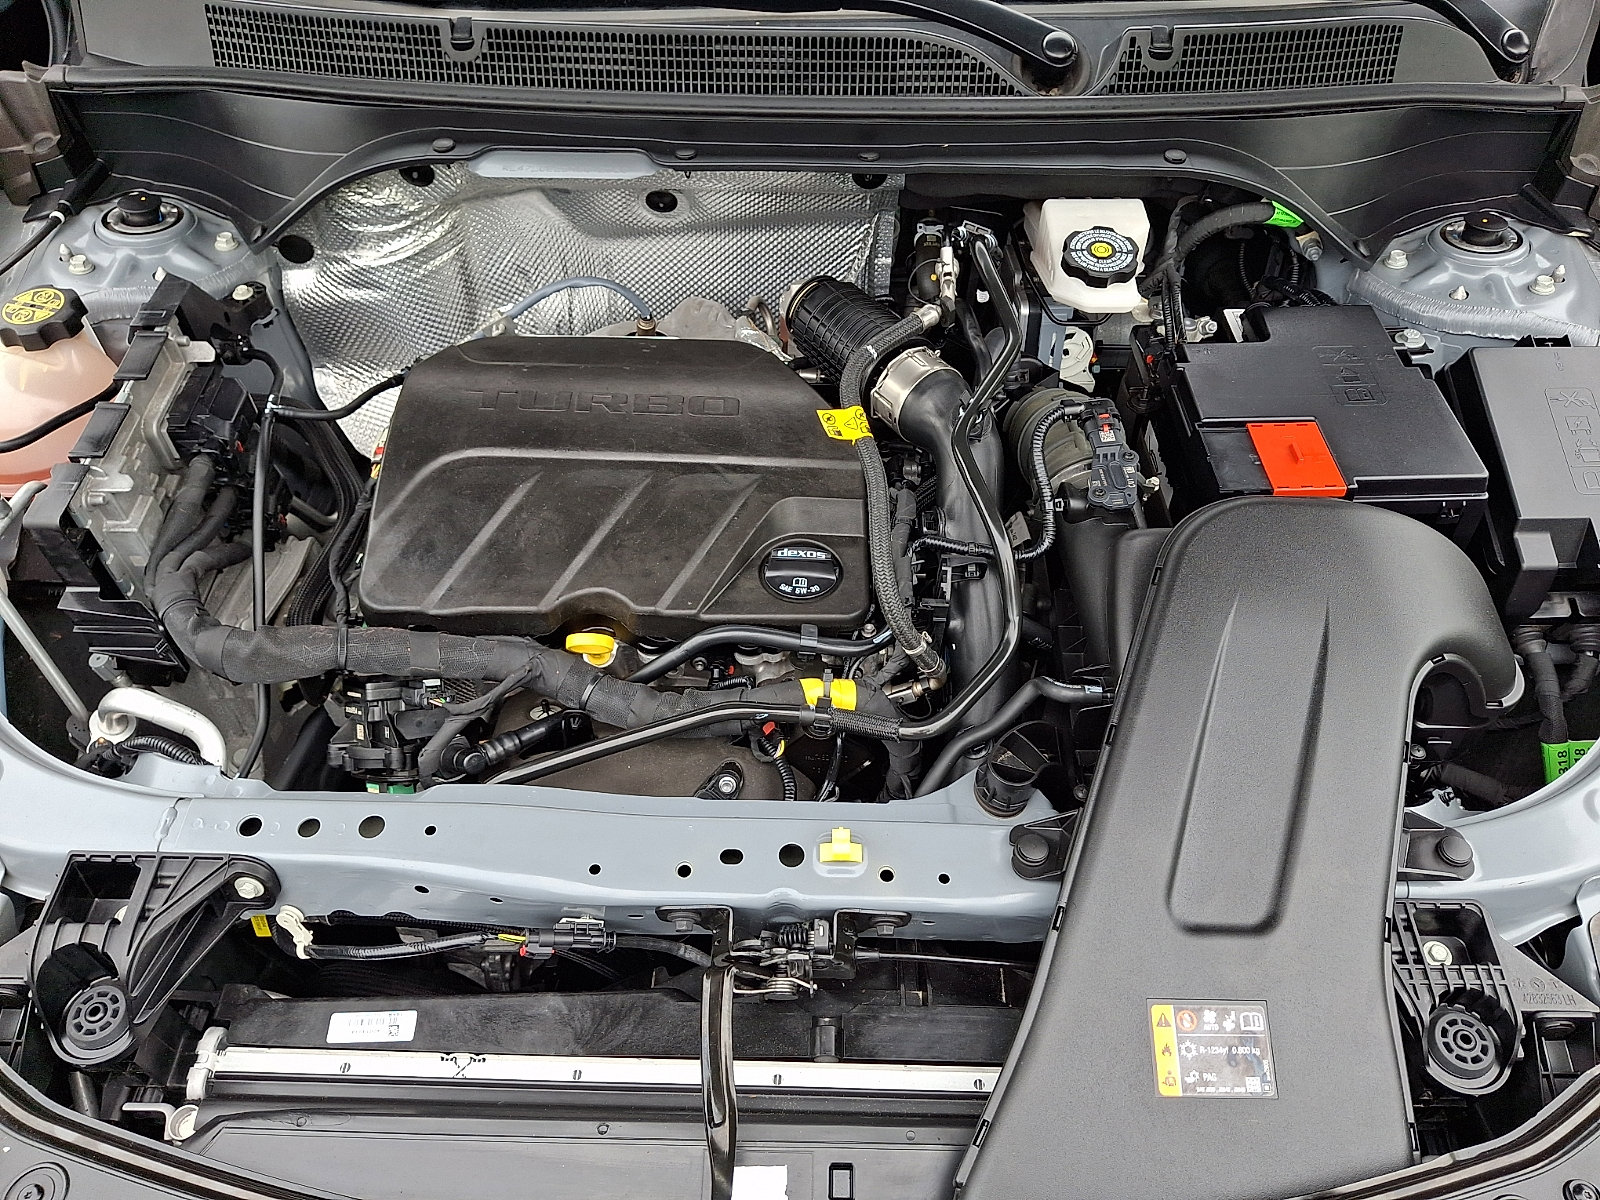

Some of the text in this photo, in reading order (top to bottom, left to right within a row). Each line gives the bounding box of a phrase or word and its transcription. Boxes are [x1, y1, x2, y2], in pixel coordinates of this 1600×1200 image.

[465, 390, 741, 417] TURBO
[777, 548, 828, 559] dexos
[779, 583, 820, 594] SAE 5W-30
[1562, 994, 1577, 1006] LH
[1203, 1072, 1218, 1081] PAG
